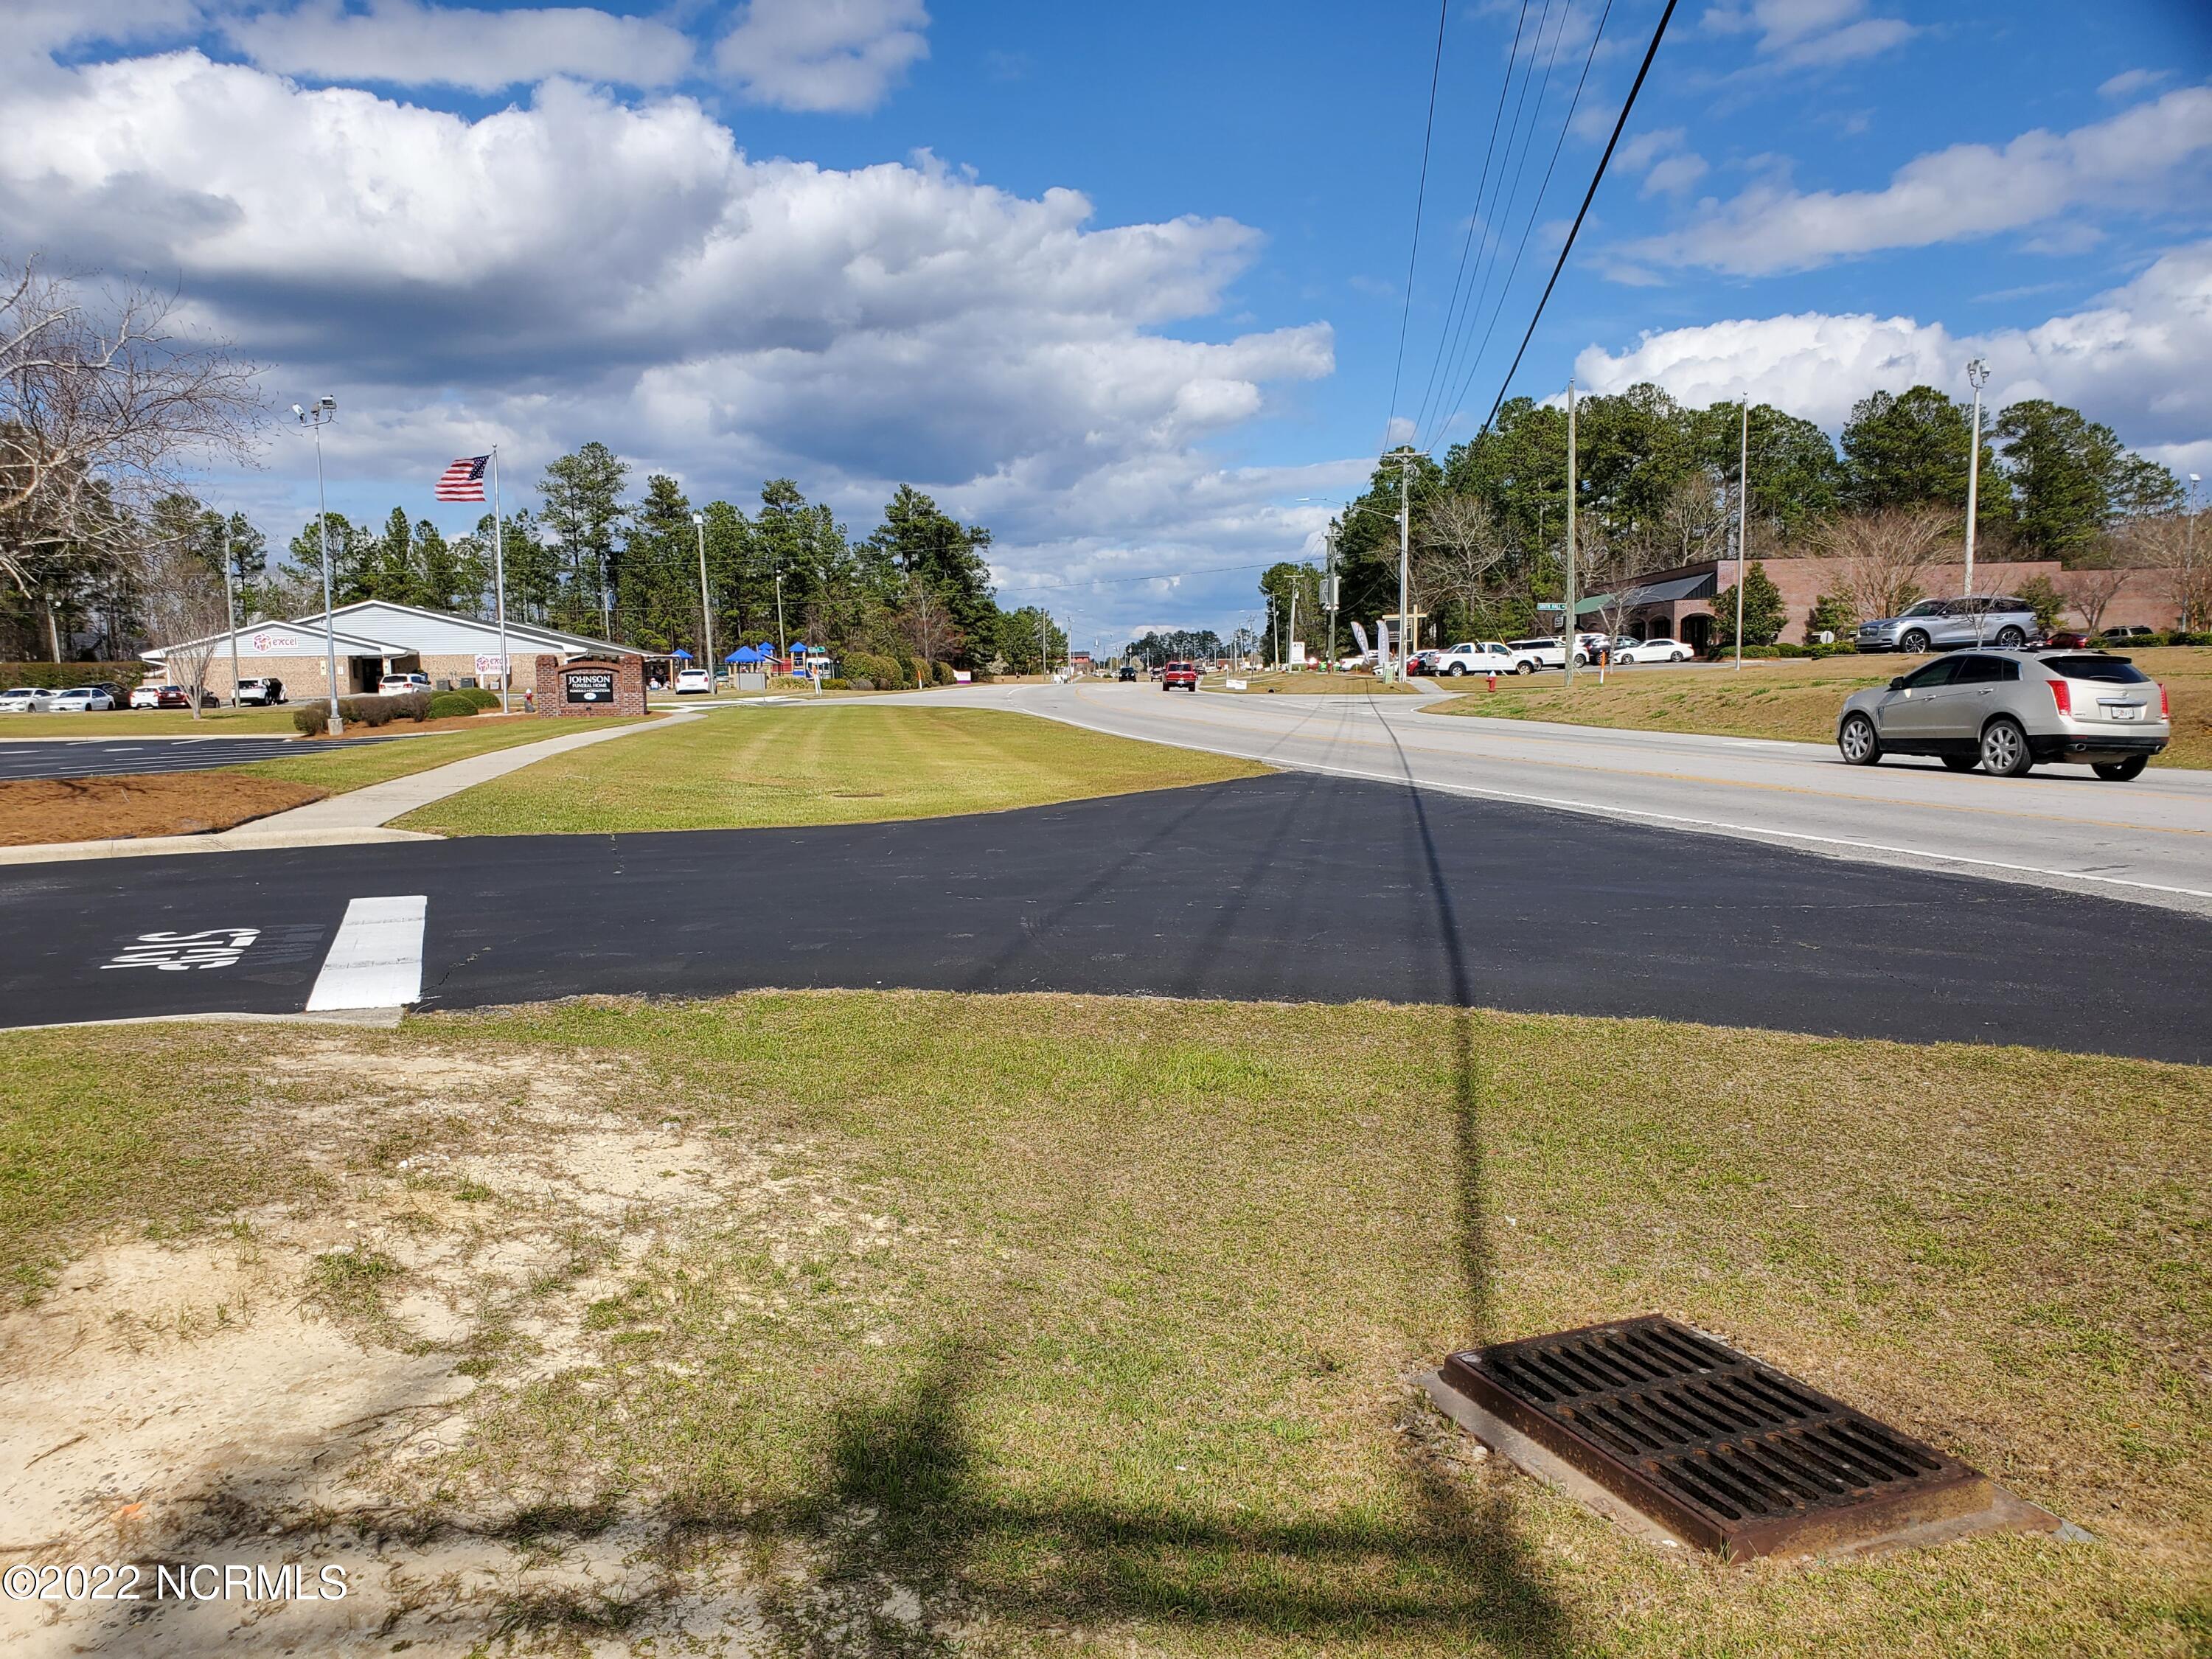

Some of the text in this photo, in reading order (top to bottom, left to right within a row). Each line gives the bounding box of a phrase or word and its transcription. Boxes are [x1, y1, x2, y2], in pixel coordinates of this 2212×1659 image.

[273, 637, 297, 646] excel
[568, 675, 611, 685] JOHNSON
[100, 928, 262, 971] STOP
